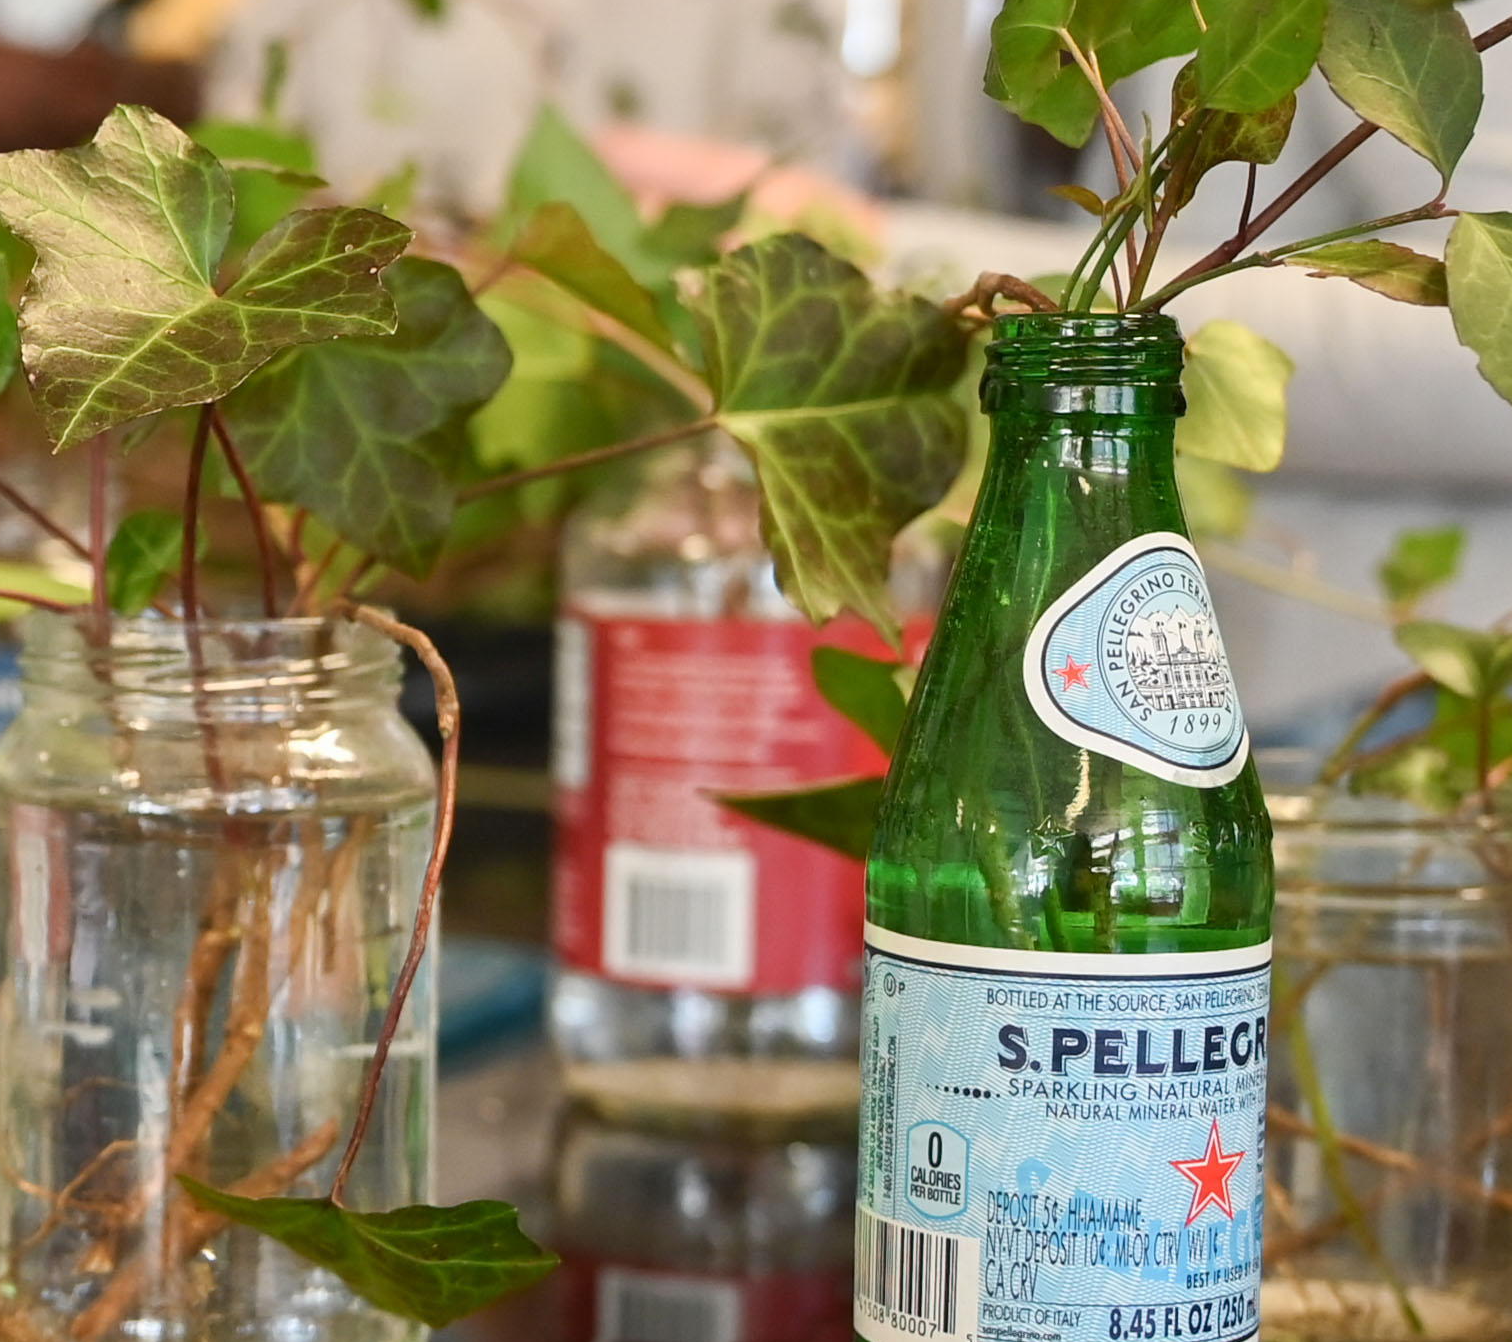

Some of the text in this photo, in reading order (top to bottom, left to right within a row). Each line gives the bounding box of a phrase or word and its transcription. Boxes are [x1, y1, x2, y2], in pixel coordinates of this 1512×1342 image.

[1106, 571, 1175, 671] PELLEGRINO
[1115, 680, 1153, 722] SAN
[1169, 712, 1222, 736] 1899
[986, 987, 1049, 1009] BOTTLED
[1053, 993, 1072, 1010] AT
[1076, 994, 1103, 1011] THE
[1108, 993, 1169, 1013] SOURCE,
[1175, 992, 1201, 1010] SAN
[1008, 1077, 1137, 1101] SPARKLING
[1148, 1077, 1230, 1100] NATURAL
[1045, 1102, 1122, 1121] NATURAL
[1128, 1103, 1193, 1121] MINERAL
[1199, 1097, 1235, 1117] WATER
[927, 1131, 943, 1168] 0
[910, 1166, 961, 1191] CALORIES
[910, 1184, 961, 1205] PER BOTTLE
[987, 1190, 1038, 1227] DEPOSIT
[1025, 1230, 1078, 1265] DEPOSIT
[985, 1259, 1038, 1301] CA CRV
[1186, 1271, 1210, 1289] BEST
[1213, 1269, 1221, 1286] IF
[1224, 1264, 1243, 1283] USED
[891, 1312, 938, 1338] 80007
[982, 1303, 1082, 1327] PRODUCT OF ITALY
[1109, 1307, 1156, 1340] 8.45
[1164, 1306, 1182, 1337] FL
[1188, 1302, 1213, 1335] OZ
[1217, 1292, 1245, 1338] (250
[982, 1326, 1062, 1342] sanpellegrino.com
